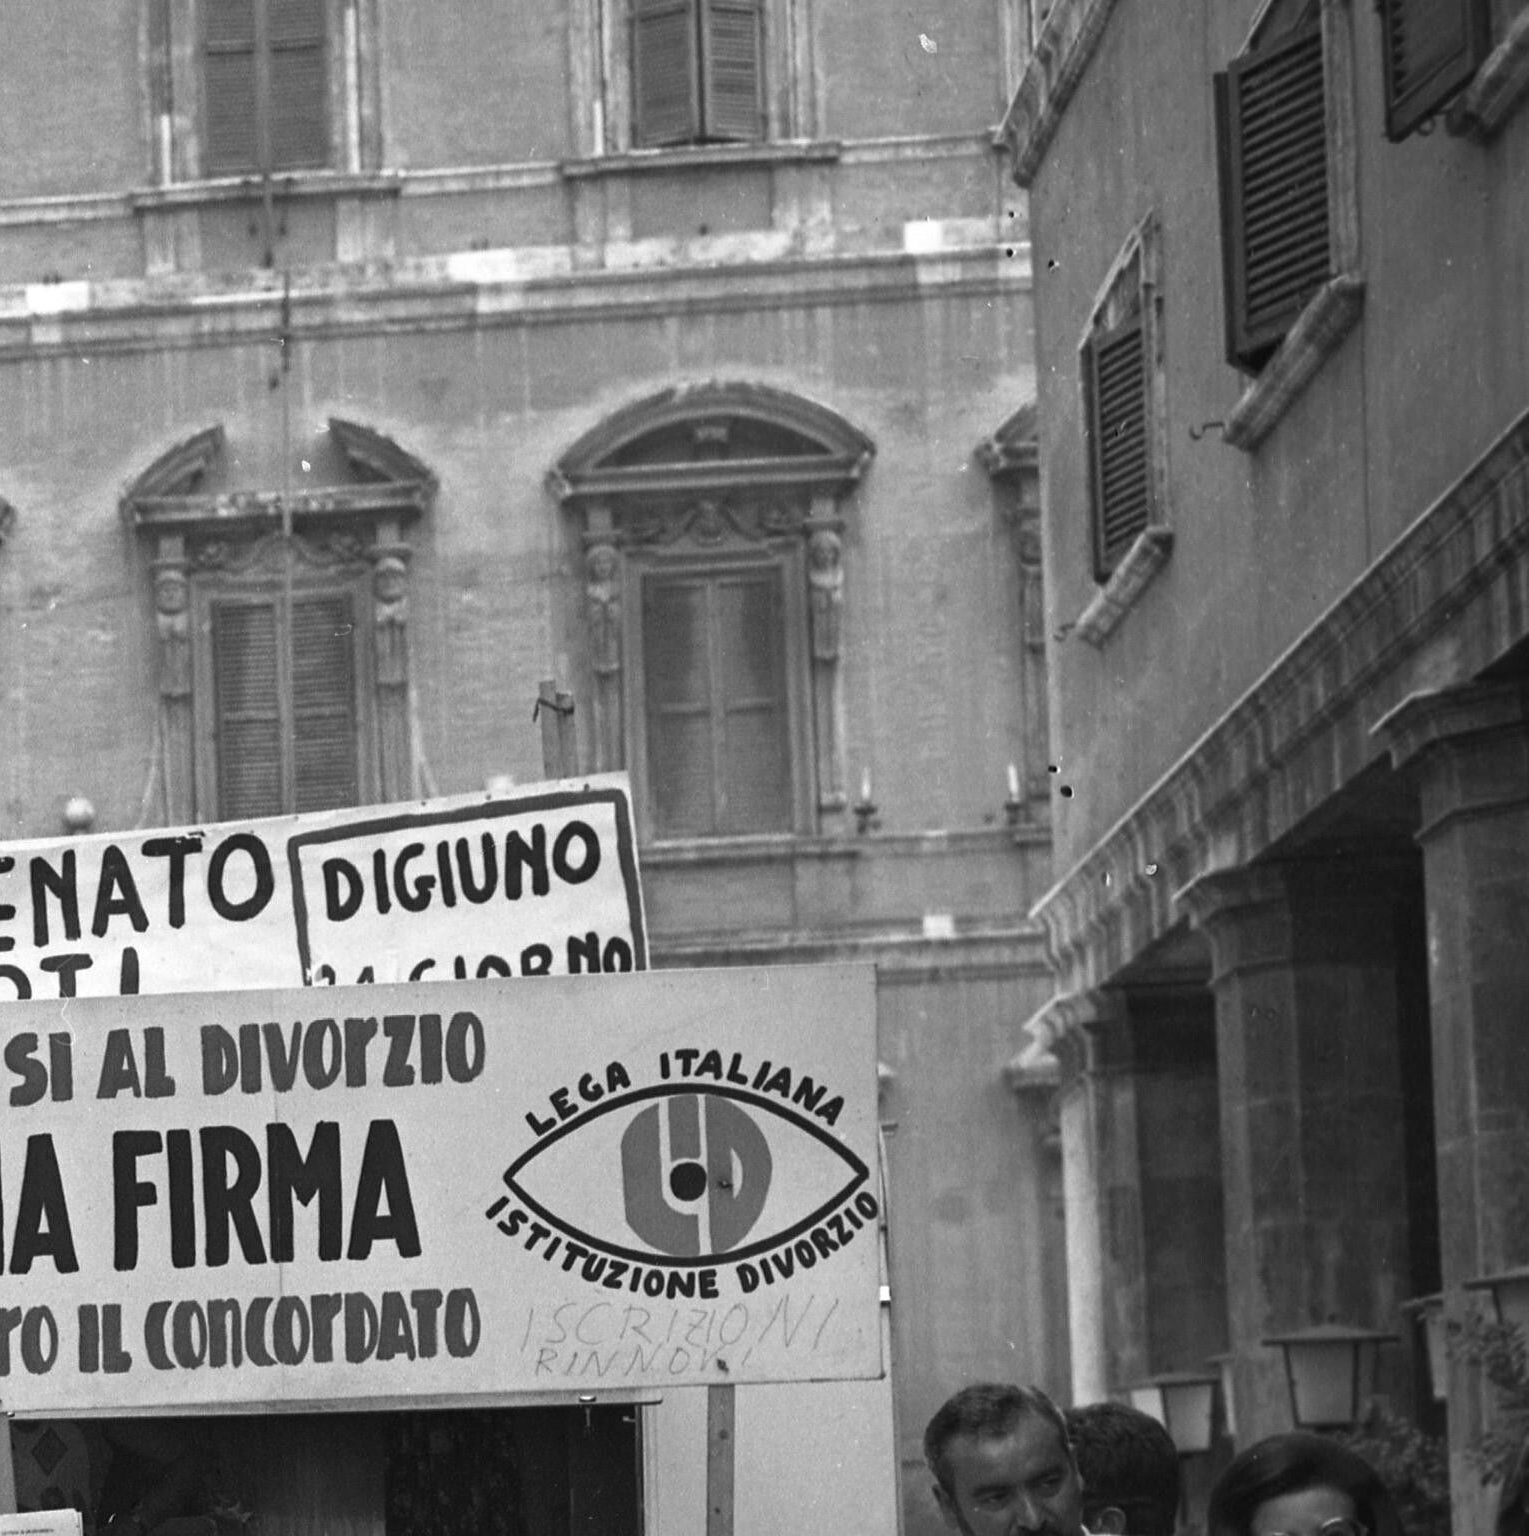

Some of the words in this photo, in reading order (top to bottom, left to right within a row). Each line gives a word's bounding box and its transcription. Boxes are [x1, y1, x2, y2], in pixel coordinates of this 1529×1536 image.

[321, 820, 602, 923] DIGIUNO
[4, 1030, 73, 1108] SI
[95, 1025, 177, 1100] AL
[524, 1061, 631, 1137] LEGA
[658, 1048, 846, 1127] ITALIANA
[111, 1118, 422, 1272] FIRMA
[484, 1195, 720, 1300] ISTITUZIONE
[735, 1190, 879, 1294] DIVORZIO
[77, 1303, 133, 1375] IL
[520, 1293, 840, 1353] ISCRIZIONI
